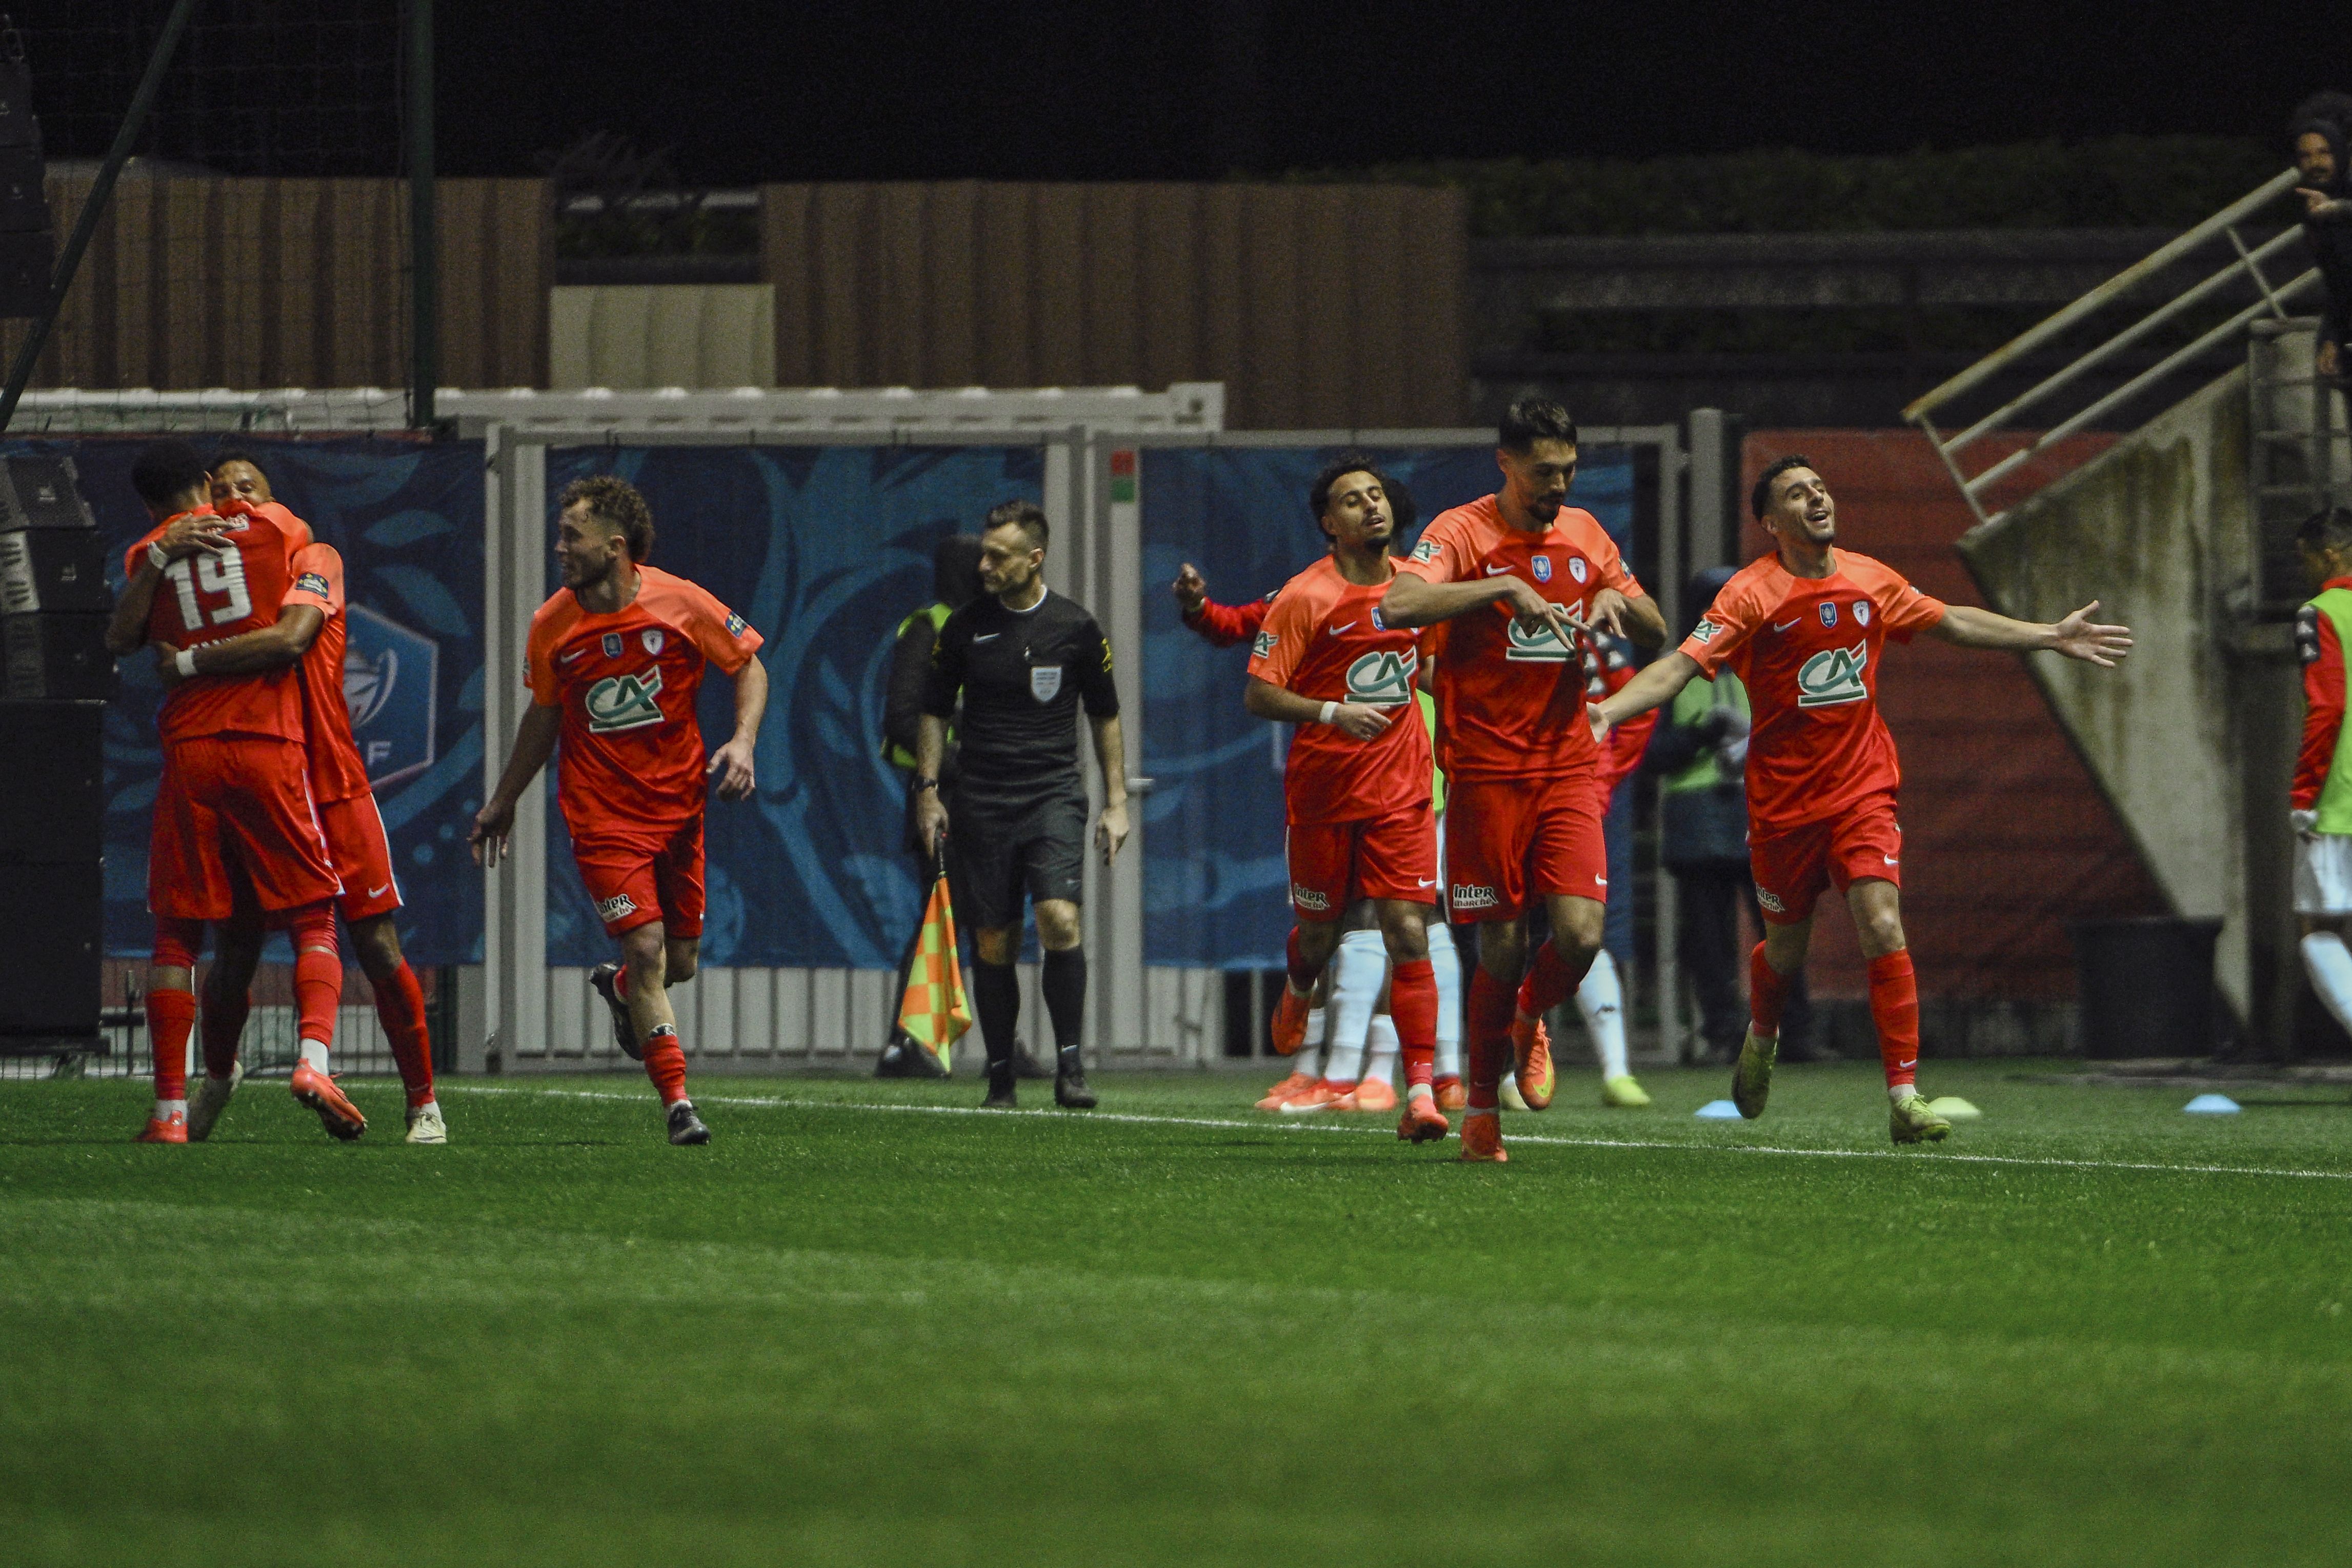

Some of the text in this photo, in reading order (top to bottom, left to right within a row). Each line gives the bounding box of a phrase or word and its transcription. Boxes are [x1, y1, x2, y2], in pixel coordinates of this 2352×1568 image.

[165, 547, 252, 631] 19
[1346, 650, 1416, 696] CA
[1799, 643, 1866, 696] CA
[585, 670, 662, 722] CA
